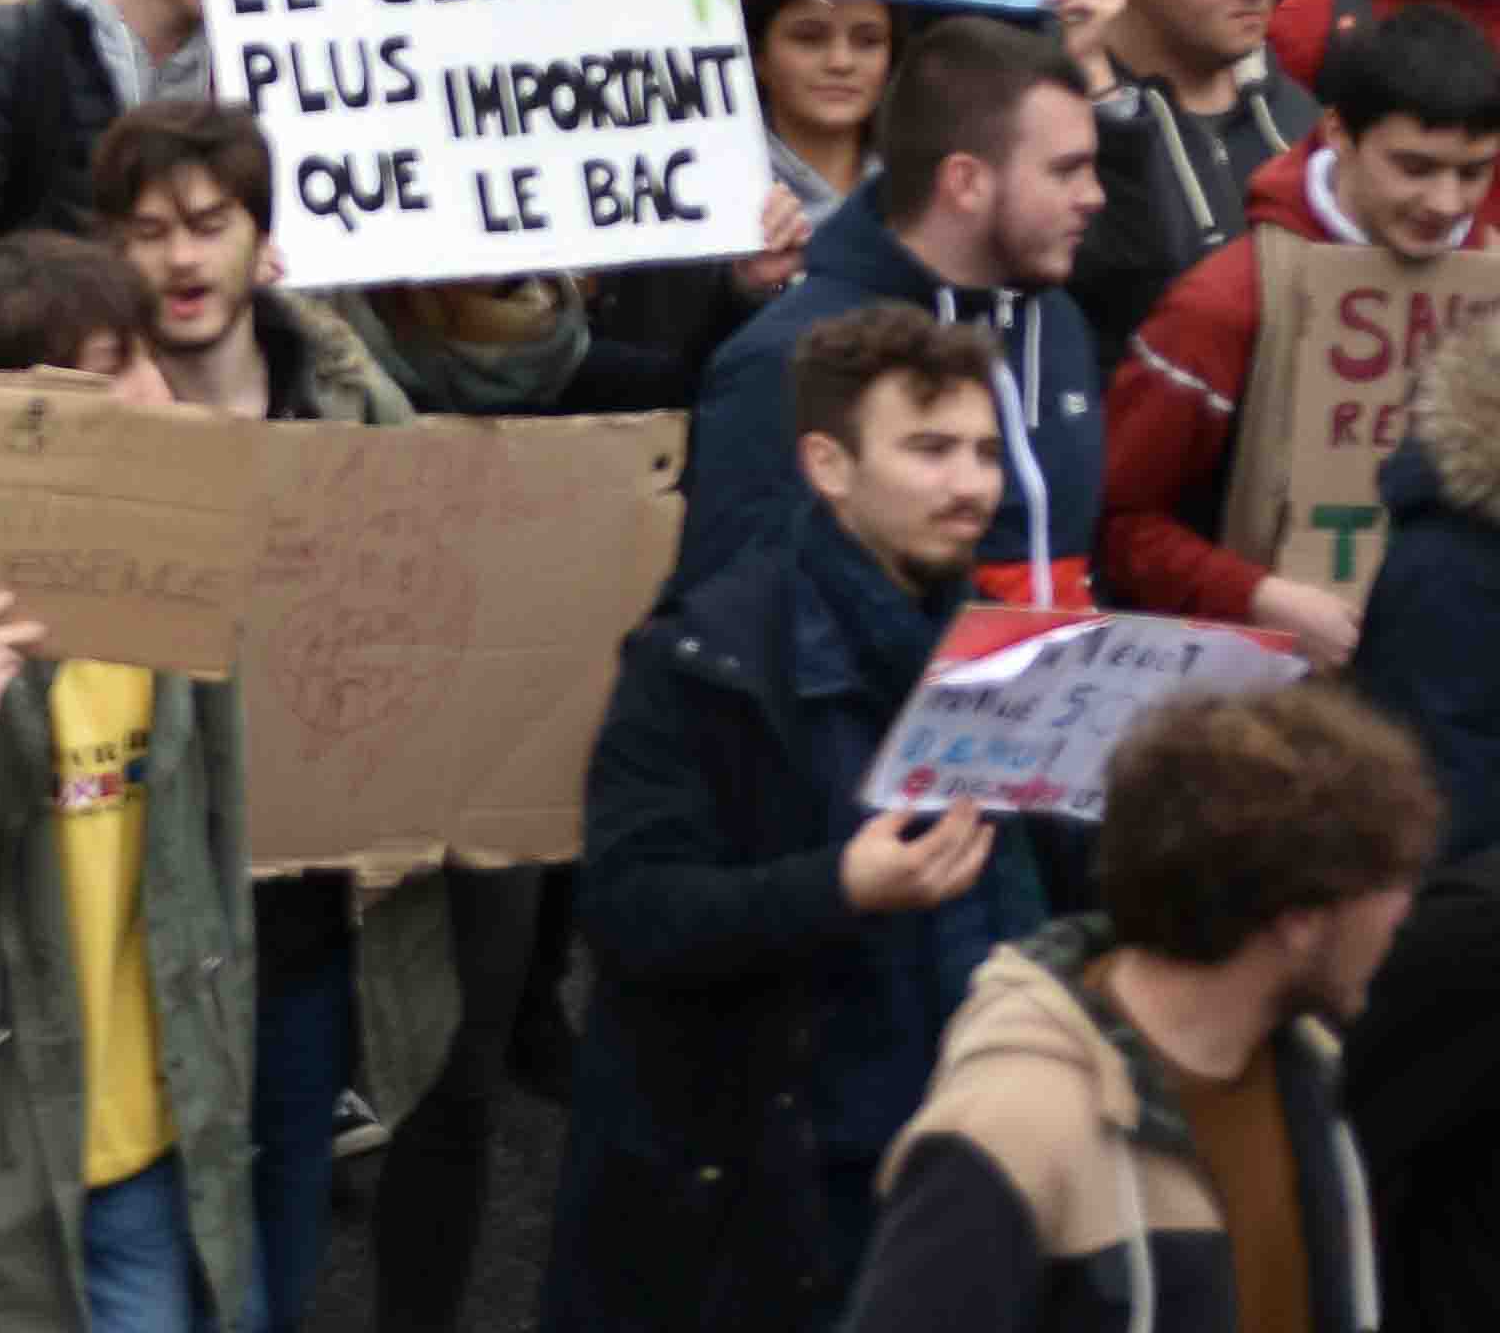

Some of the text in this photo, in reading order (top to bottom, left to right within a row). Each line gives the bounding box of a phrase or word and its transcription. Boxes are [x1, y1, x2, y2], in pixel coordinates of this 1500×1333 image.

[240, 35, 745, 141] PLUS IMPORTANT
[296, 146, 710, 236] QUE LE BAC
